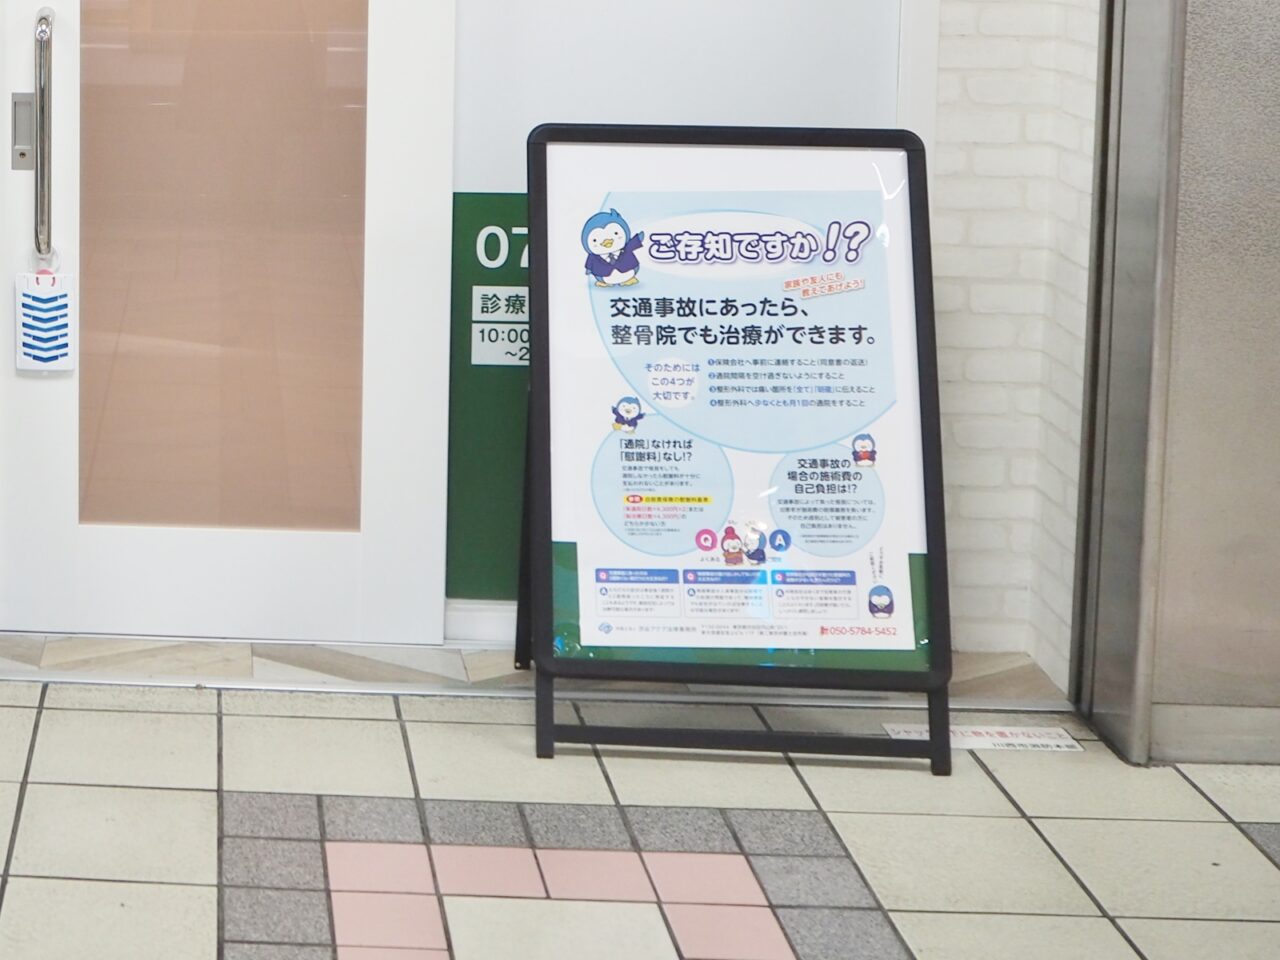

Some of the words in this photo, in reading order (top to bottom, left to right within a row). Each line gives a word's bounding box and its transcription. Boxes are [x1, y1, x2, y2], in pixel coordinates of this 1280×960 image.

[648, 221, 872, 264] ご存知ですか!?
[480, 293, 527, 315] 診療
[610, 297, 809, 318] 交通事故にあったら、
[611, 325, 875, 346] 整骨院でも治療ができます。
[645, 362, 701, 373] そのためには
[651, 377, 695, 387] この4つが
[652, 391, 696, 401] 大切です。
[620, 439, 693, 450] 「通院」なければ
[797, 459, 851, 469] 交通事故の
[787, 471, 862, 481] 場合の施術費の
[794, 484, 858, 494] 自己負担は!?
